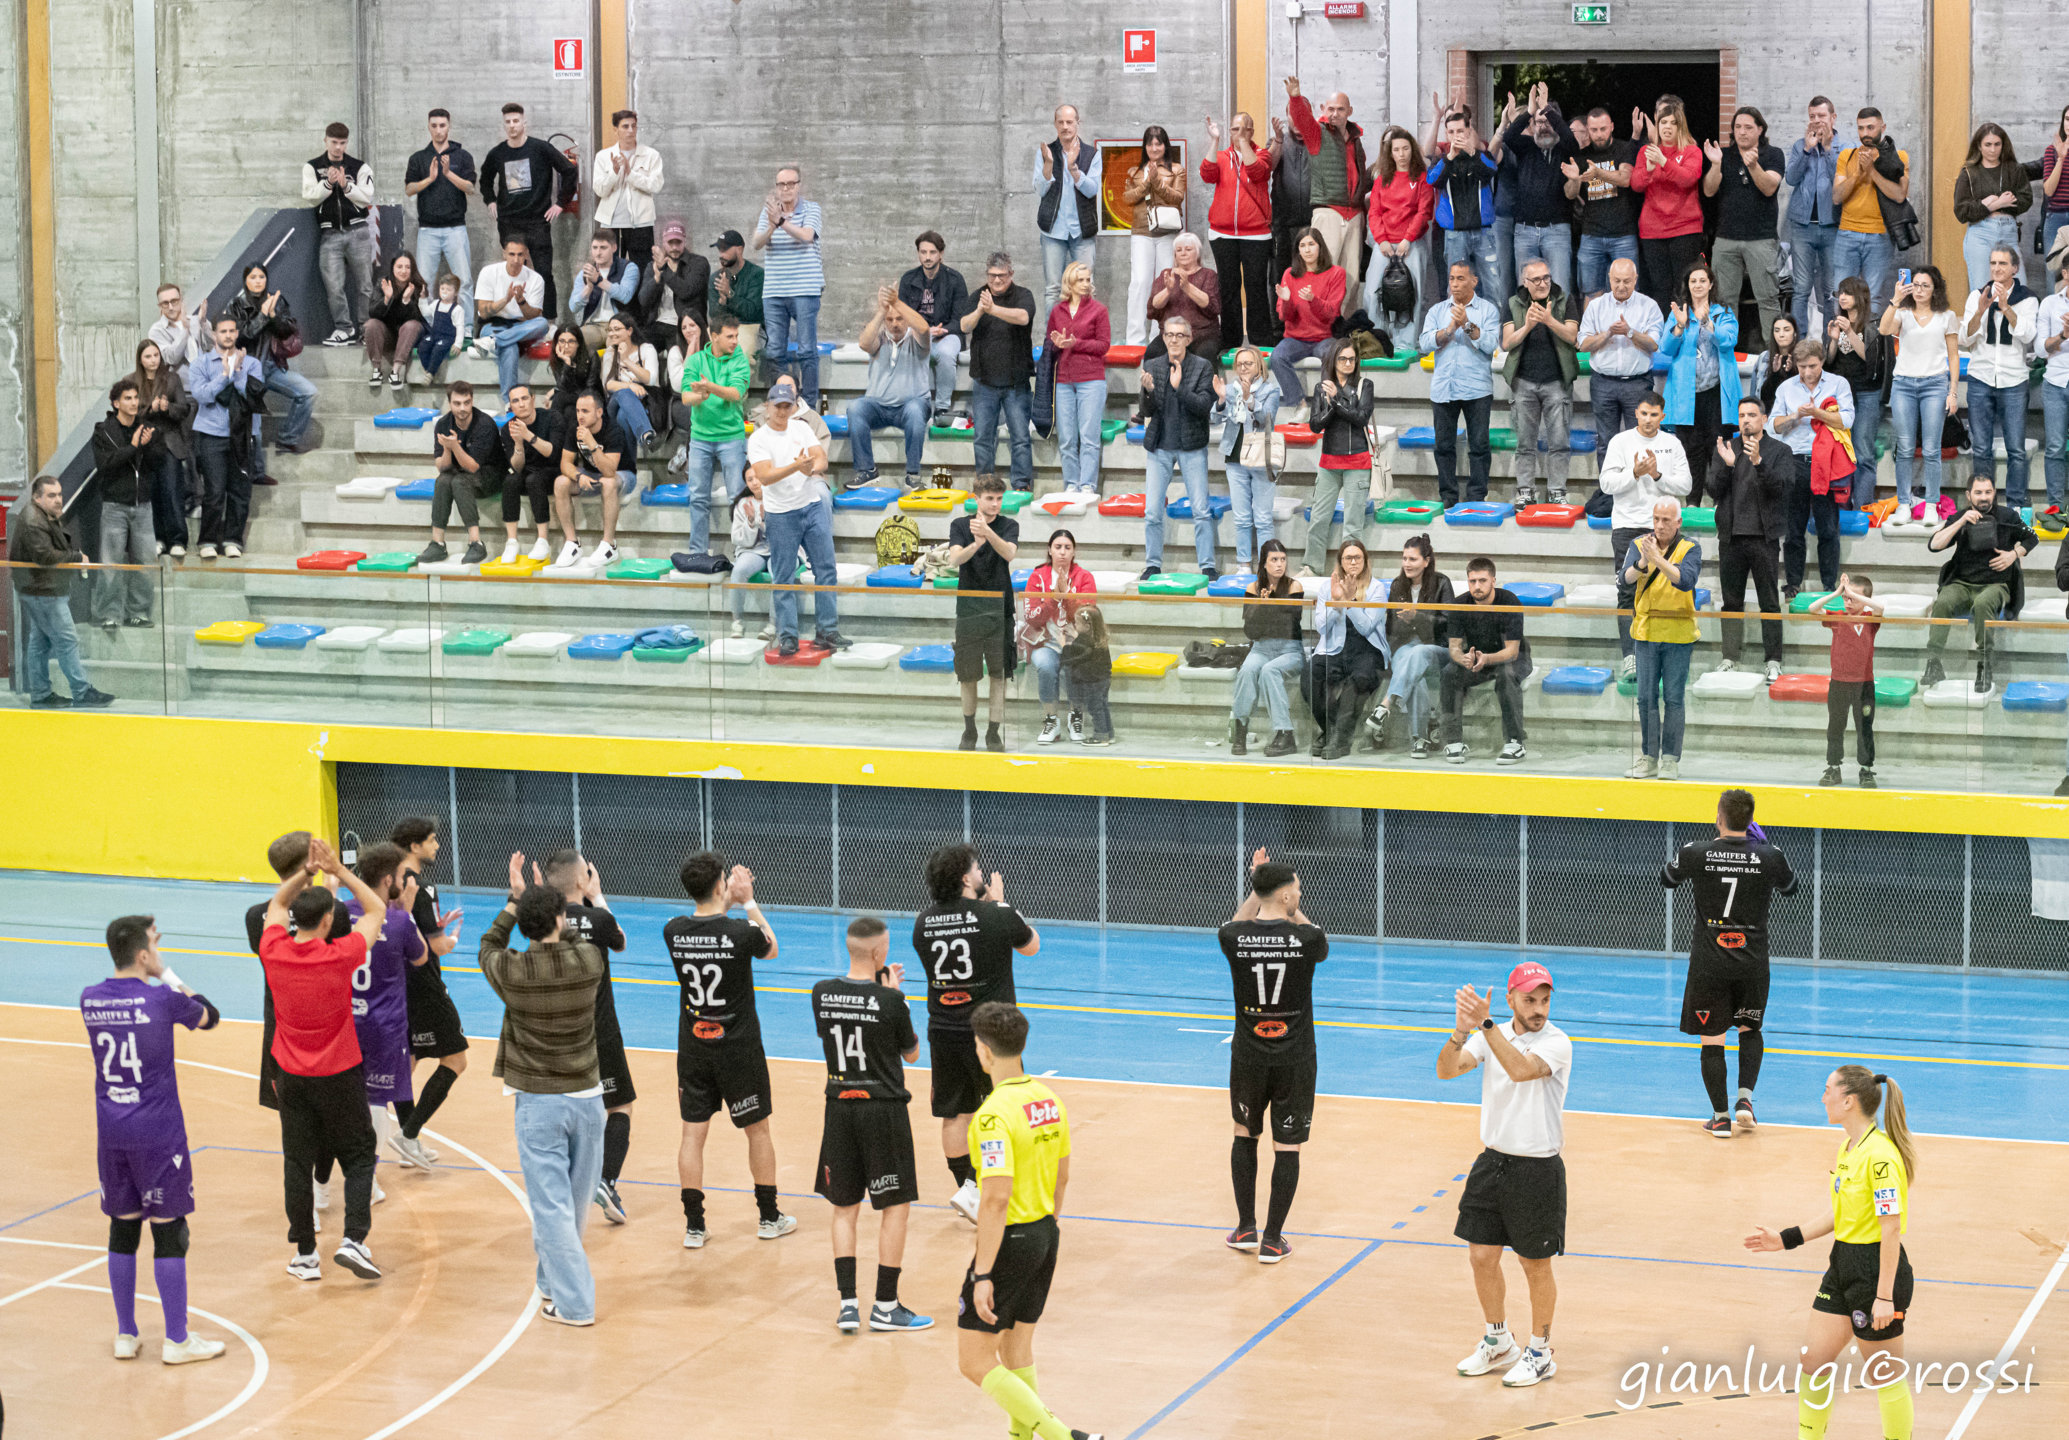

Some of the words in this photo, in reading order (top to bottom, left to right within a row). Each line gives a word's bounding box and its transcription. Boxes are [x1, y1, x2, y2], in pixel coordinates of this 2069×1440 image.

[1705, 850, 1748, 860] GAMIFER
[1716, 865, 1744, 873] IMPIANTI
[1721, 877, 1738, 918] 7
[925, 913, 963, 924] GAMIFER
[934, 928, 961, 937] IMPIANTI
[673, 934, 718, 944] GAMIFER
[1237, 934, 1286, 944] GAMIFER
[684, 952, 714, 960] IMPIANTI
[931, 938, 973, 980] 23
[681, 963, 727, 1007] 32
[1251, 962, 1287, 1005] 17
[820, 993, 865, 1005] GAMIFER
[84, 1010, 131, 1021] GAMIFER
[831, 1011, 860, 1020] IMPIANTI
[829, 1024, 867, 1072] 14
[97, 1031, 143, 1083] 24
[731, 1094, 760, 1112] MARTE
[1029, 1102, 1059, 1126] Lete
[980, 1140, 1003, 1151] NET
[870, 1174, 900, 1189] MARTE
[1874, 1188, 1896, 1200] NET
